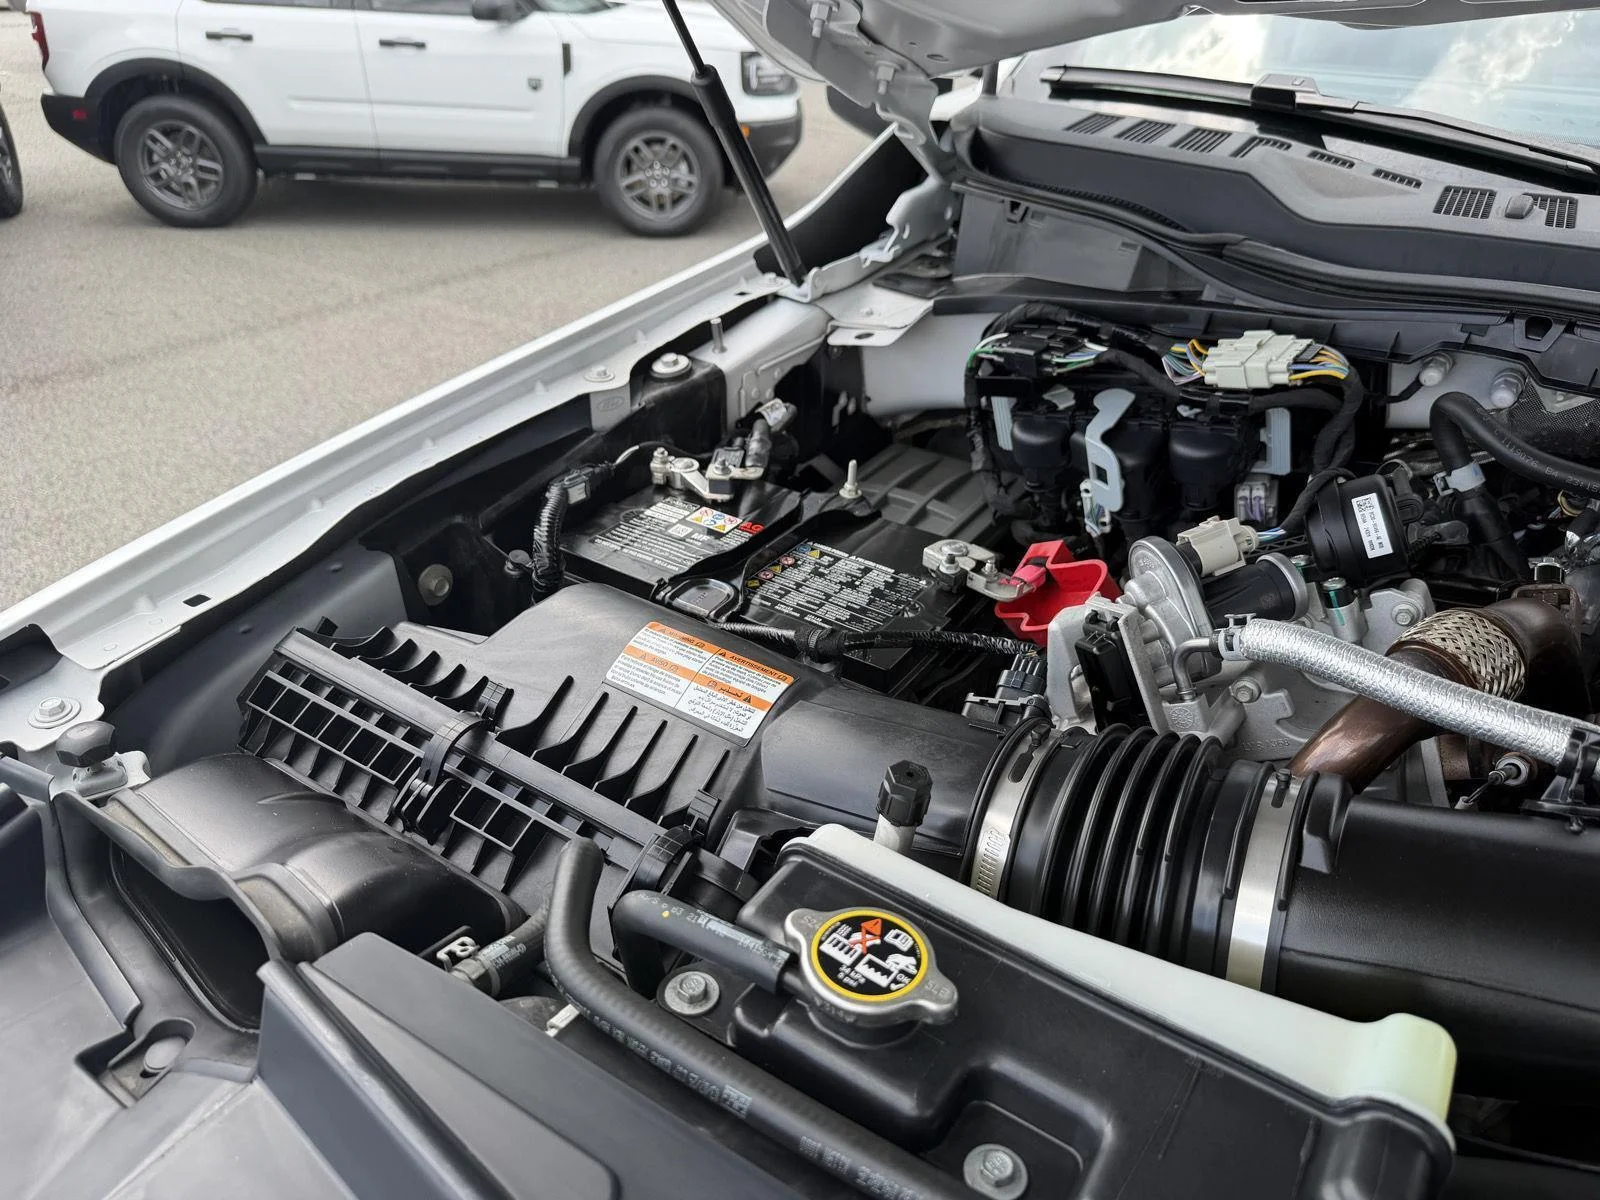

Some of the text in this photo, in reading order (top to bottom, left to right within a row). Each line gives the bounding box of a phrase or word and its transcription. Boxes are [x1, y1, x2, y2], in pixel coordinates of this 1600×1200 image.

[729, 654, 778, 677] AVERTISSEMENT
[838, 964, 866, 984] 34 kPa
[842, 976, 858, 987] psi
[896, 973, 911, 984] OK
